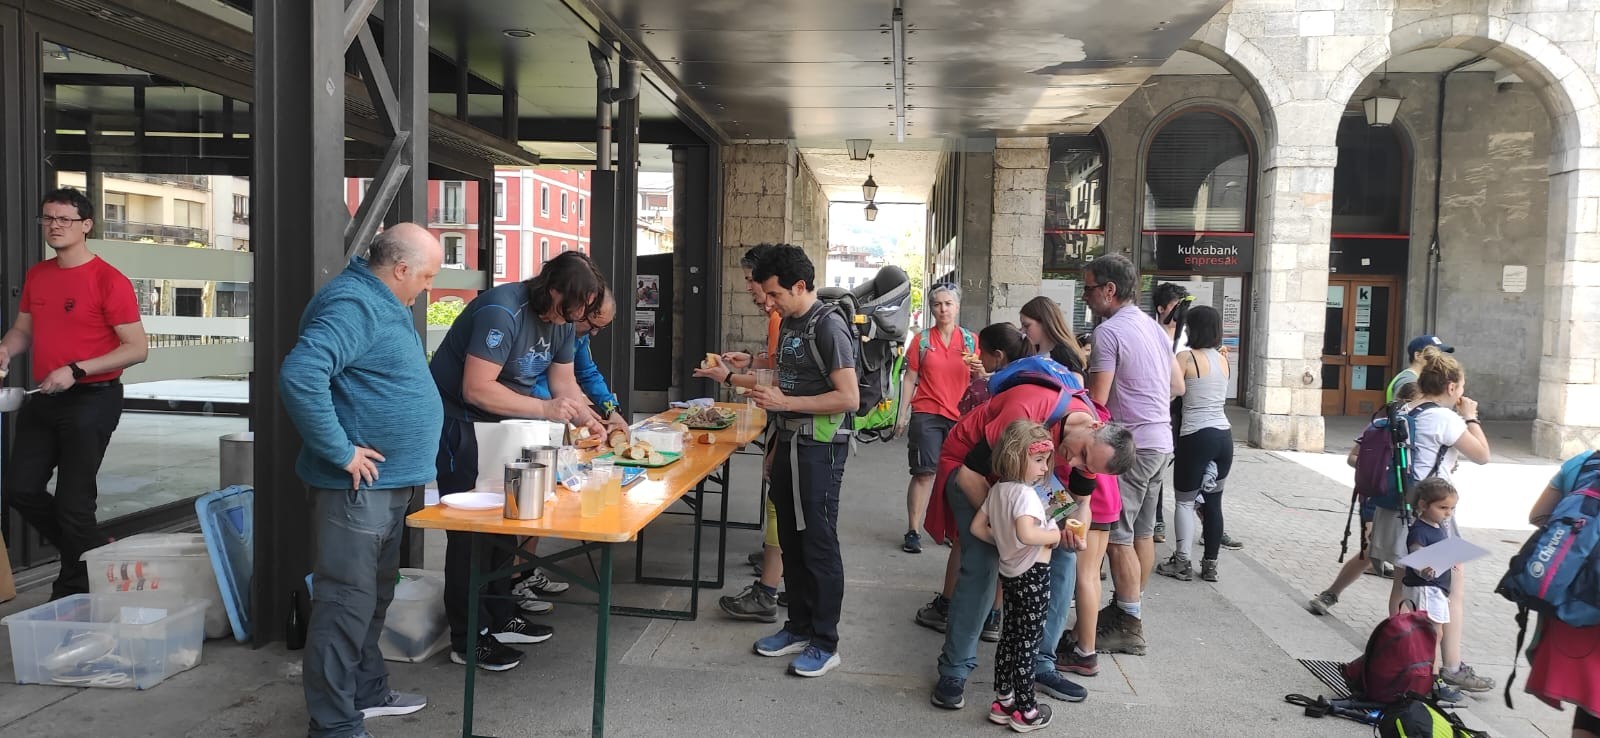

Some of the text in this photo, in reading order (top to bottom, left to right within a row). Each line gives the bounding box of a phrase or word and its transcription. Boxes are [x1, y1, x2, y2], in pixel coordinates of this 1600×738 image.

[1178, 244, 1238, 255] kutxabank
[1184, 256, 1238, 267] enpresak
[1360, 288, 1369, 300] k
